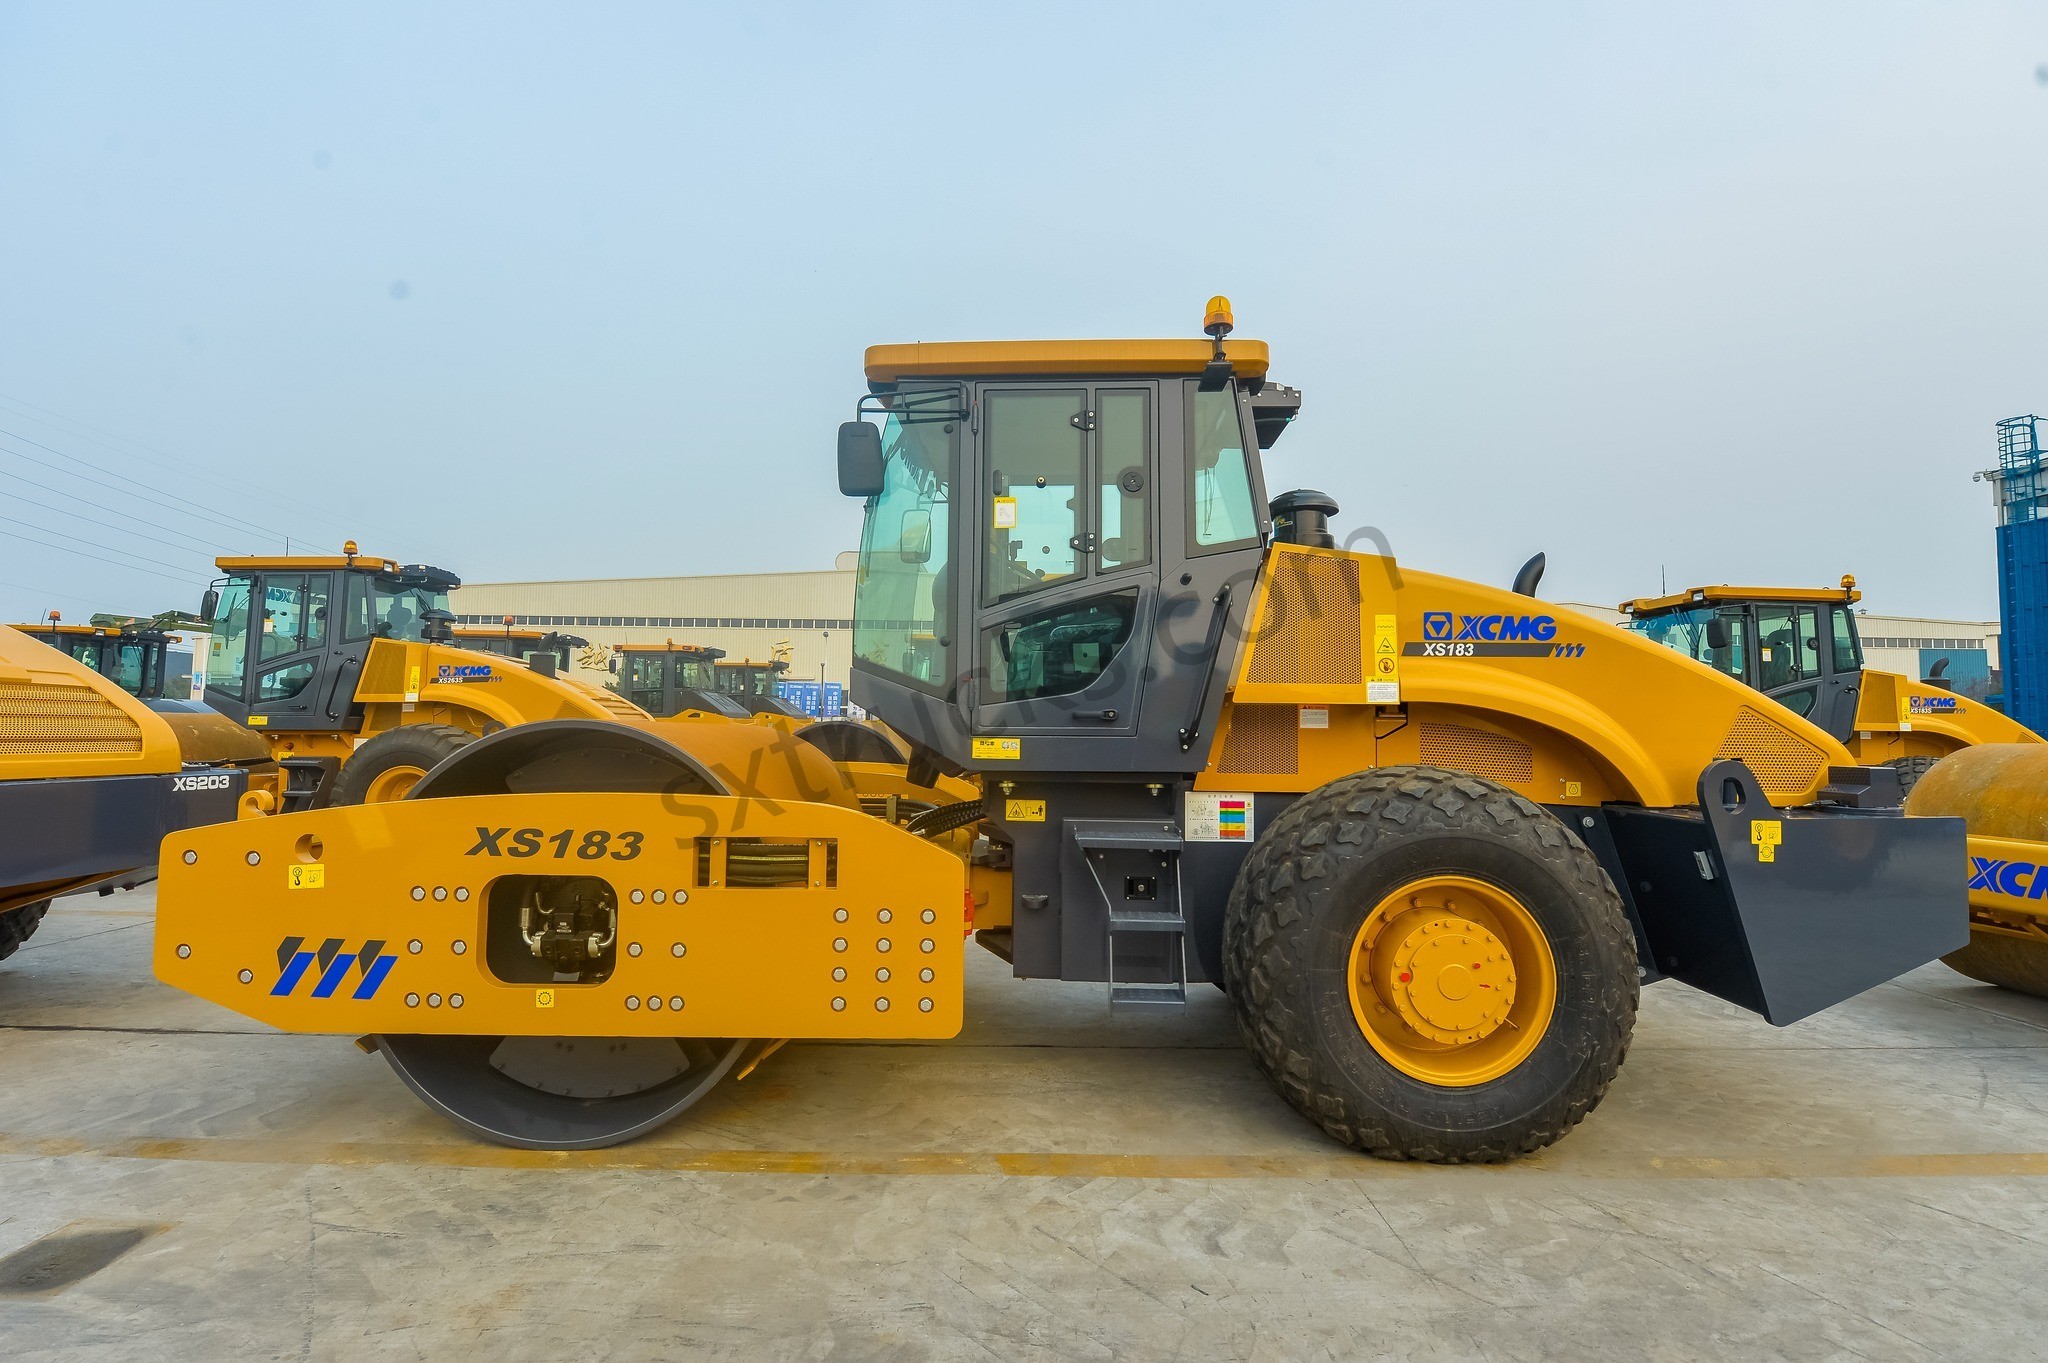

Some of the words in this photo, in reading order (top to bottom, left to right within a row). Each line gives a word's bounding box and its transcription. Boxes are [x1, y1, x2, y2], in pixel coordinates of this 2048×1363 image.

[1454, 615, 1557, 641] XCMG
[1423, 643, 1475, 657] XS183
[452, 665, 491, 676] XCMG
[1922, 697, 1956, 707] XCMG
[172, 775, 230, 792] XS203
[464, 826, 645, 861] XS183
